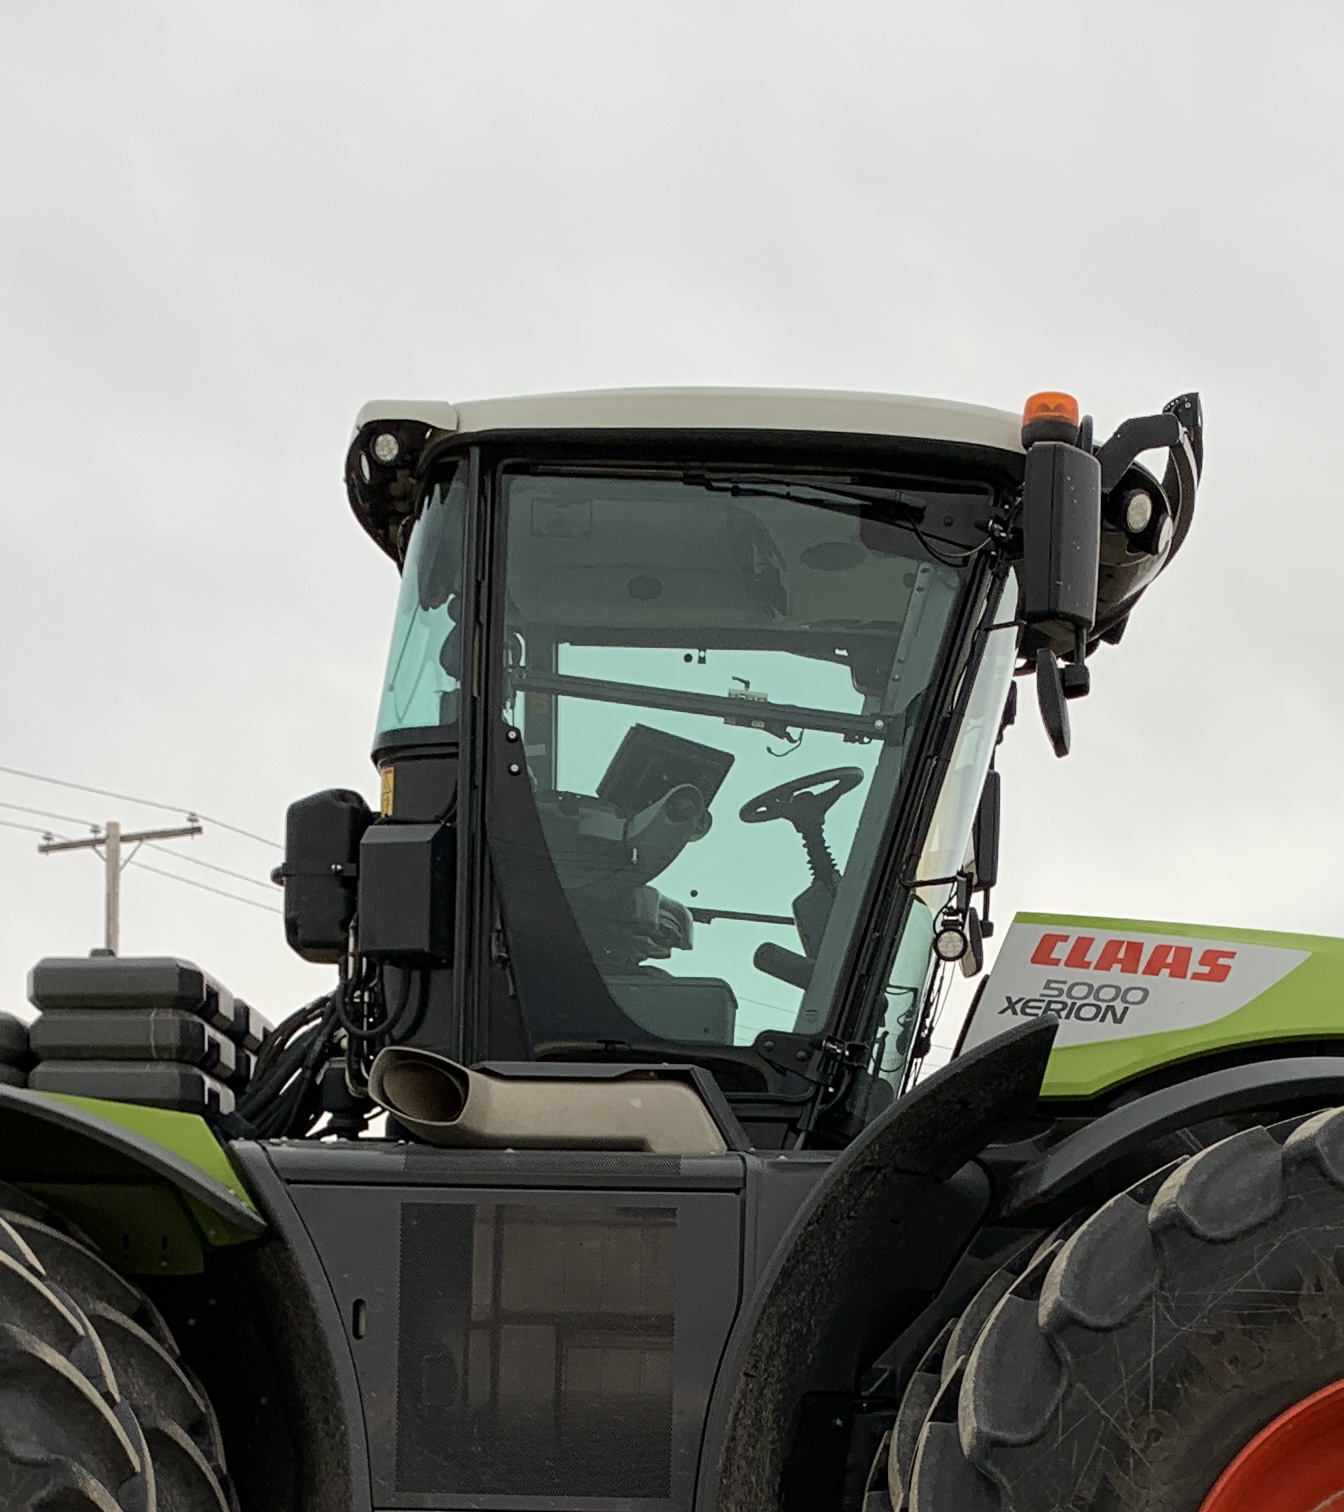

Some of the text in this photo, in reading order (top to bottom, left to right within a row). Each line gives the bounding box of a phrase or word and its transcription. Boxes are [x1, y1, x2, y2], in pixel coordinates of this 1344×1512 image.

[1031, 933, 1237, 983] CLAAS
[1040, 979, 1150, 1006] 5000
[998, 996, 1129, 1025] XERION
